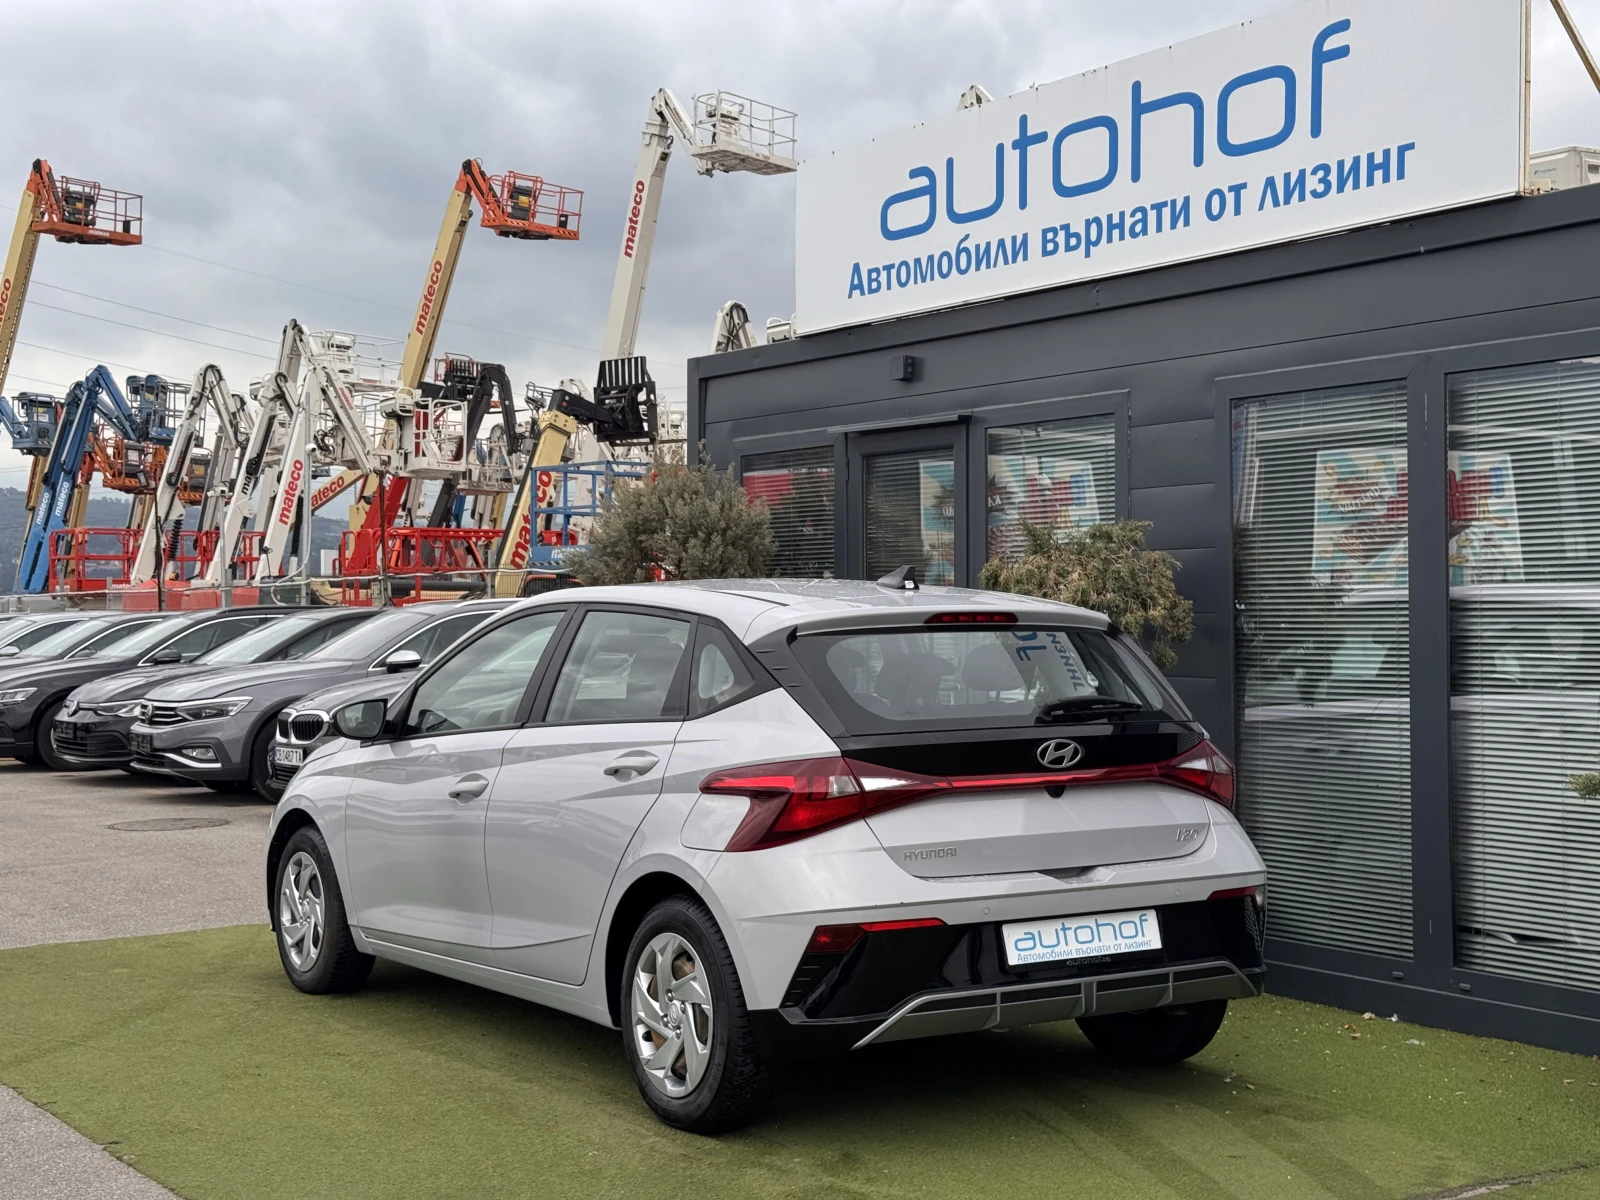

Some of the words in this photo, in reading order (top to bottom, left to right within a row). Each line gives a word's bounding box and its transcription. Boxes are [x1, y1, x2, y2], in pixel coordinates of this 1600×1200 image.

[880, 19, 1350, 241] autohof
[624, 180, 645, 258] mateco
[849, 233, 1028, 297] Автомобили
[1042, 195, 1190, 257] върнати
[1205, 182, 1247, 222] от
[1259, 142, 1415, 211] лизинг
[416, 260, 442, 336] mateco
[36, 492, 50, 525] mateco
[54, 481, 69, 517] mateco
[279, 459, 303, 525] mateco
[311, 475, 345, 507] ateco
[904, 845, 958, 861] HYUNDAI
[1014, 913, 1148, 952] autohof
[1017, 949, 1073, 963] Автомобили
[1075, 943, 1111, 956] върнати
[1113, 942, 1122, 952] от
[1124, 939, 1153, 951] лизинг
